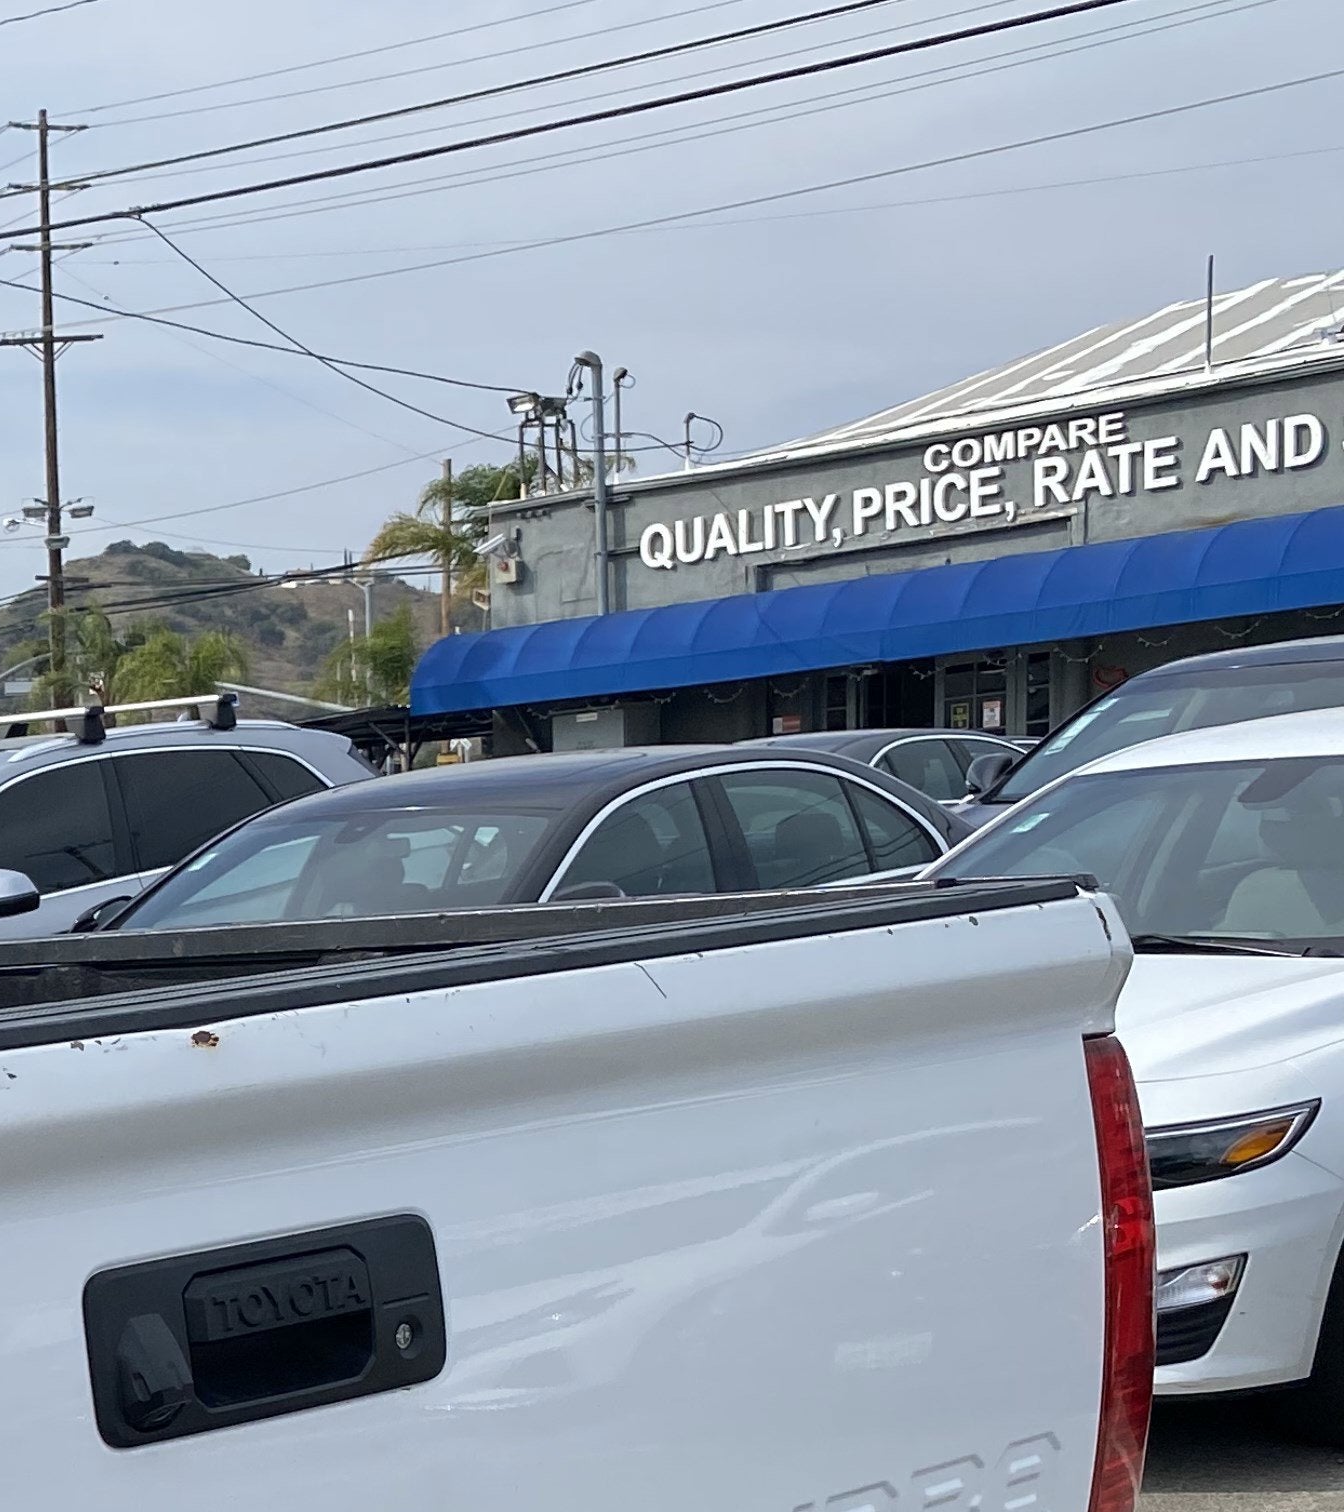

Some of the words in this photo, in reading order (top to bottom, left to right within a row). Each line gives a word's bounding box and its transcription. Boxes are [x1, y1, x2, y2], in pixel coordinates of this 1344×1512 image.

[923, 412, 1126, 473] COMPARE
[639, 493, 844, 569] QUALITY,
[853, 466, 1017, 523] PRICE,
[1033, 436, 1180, 507] RATE
[1195, 413, 1326, 483] AND
[210, 1274, 366, 1332] TOYOTA
